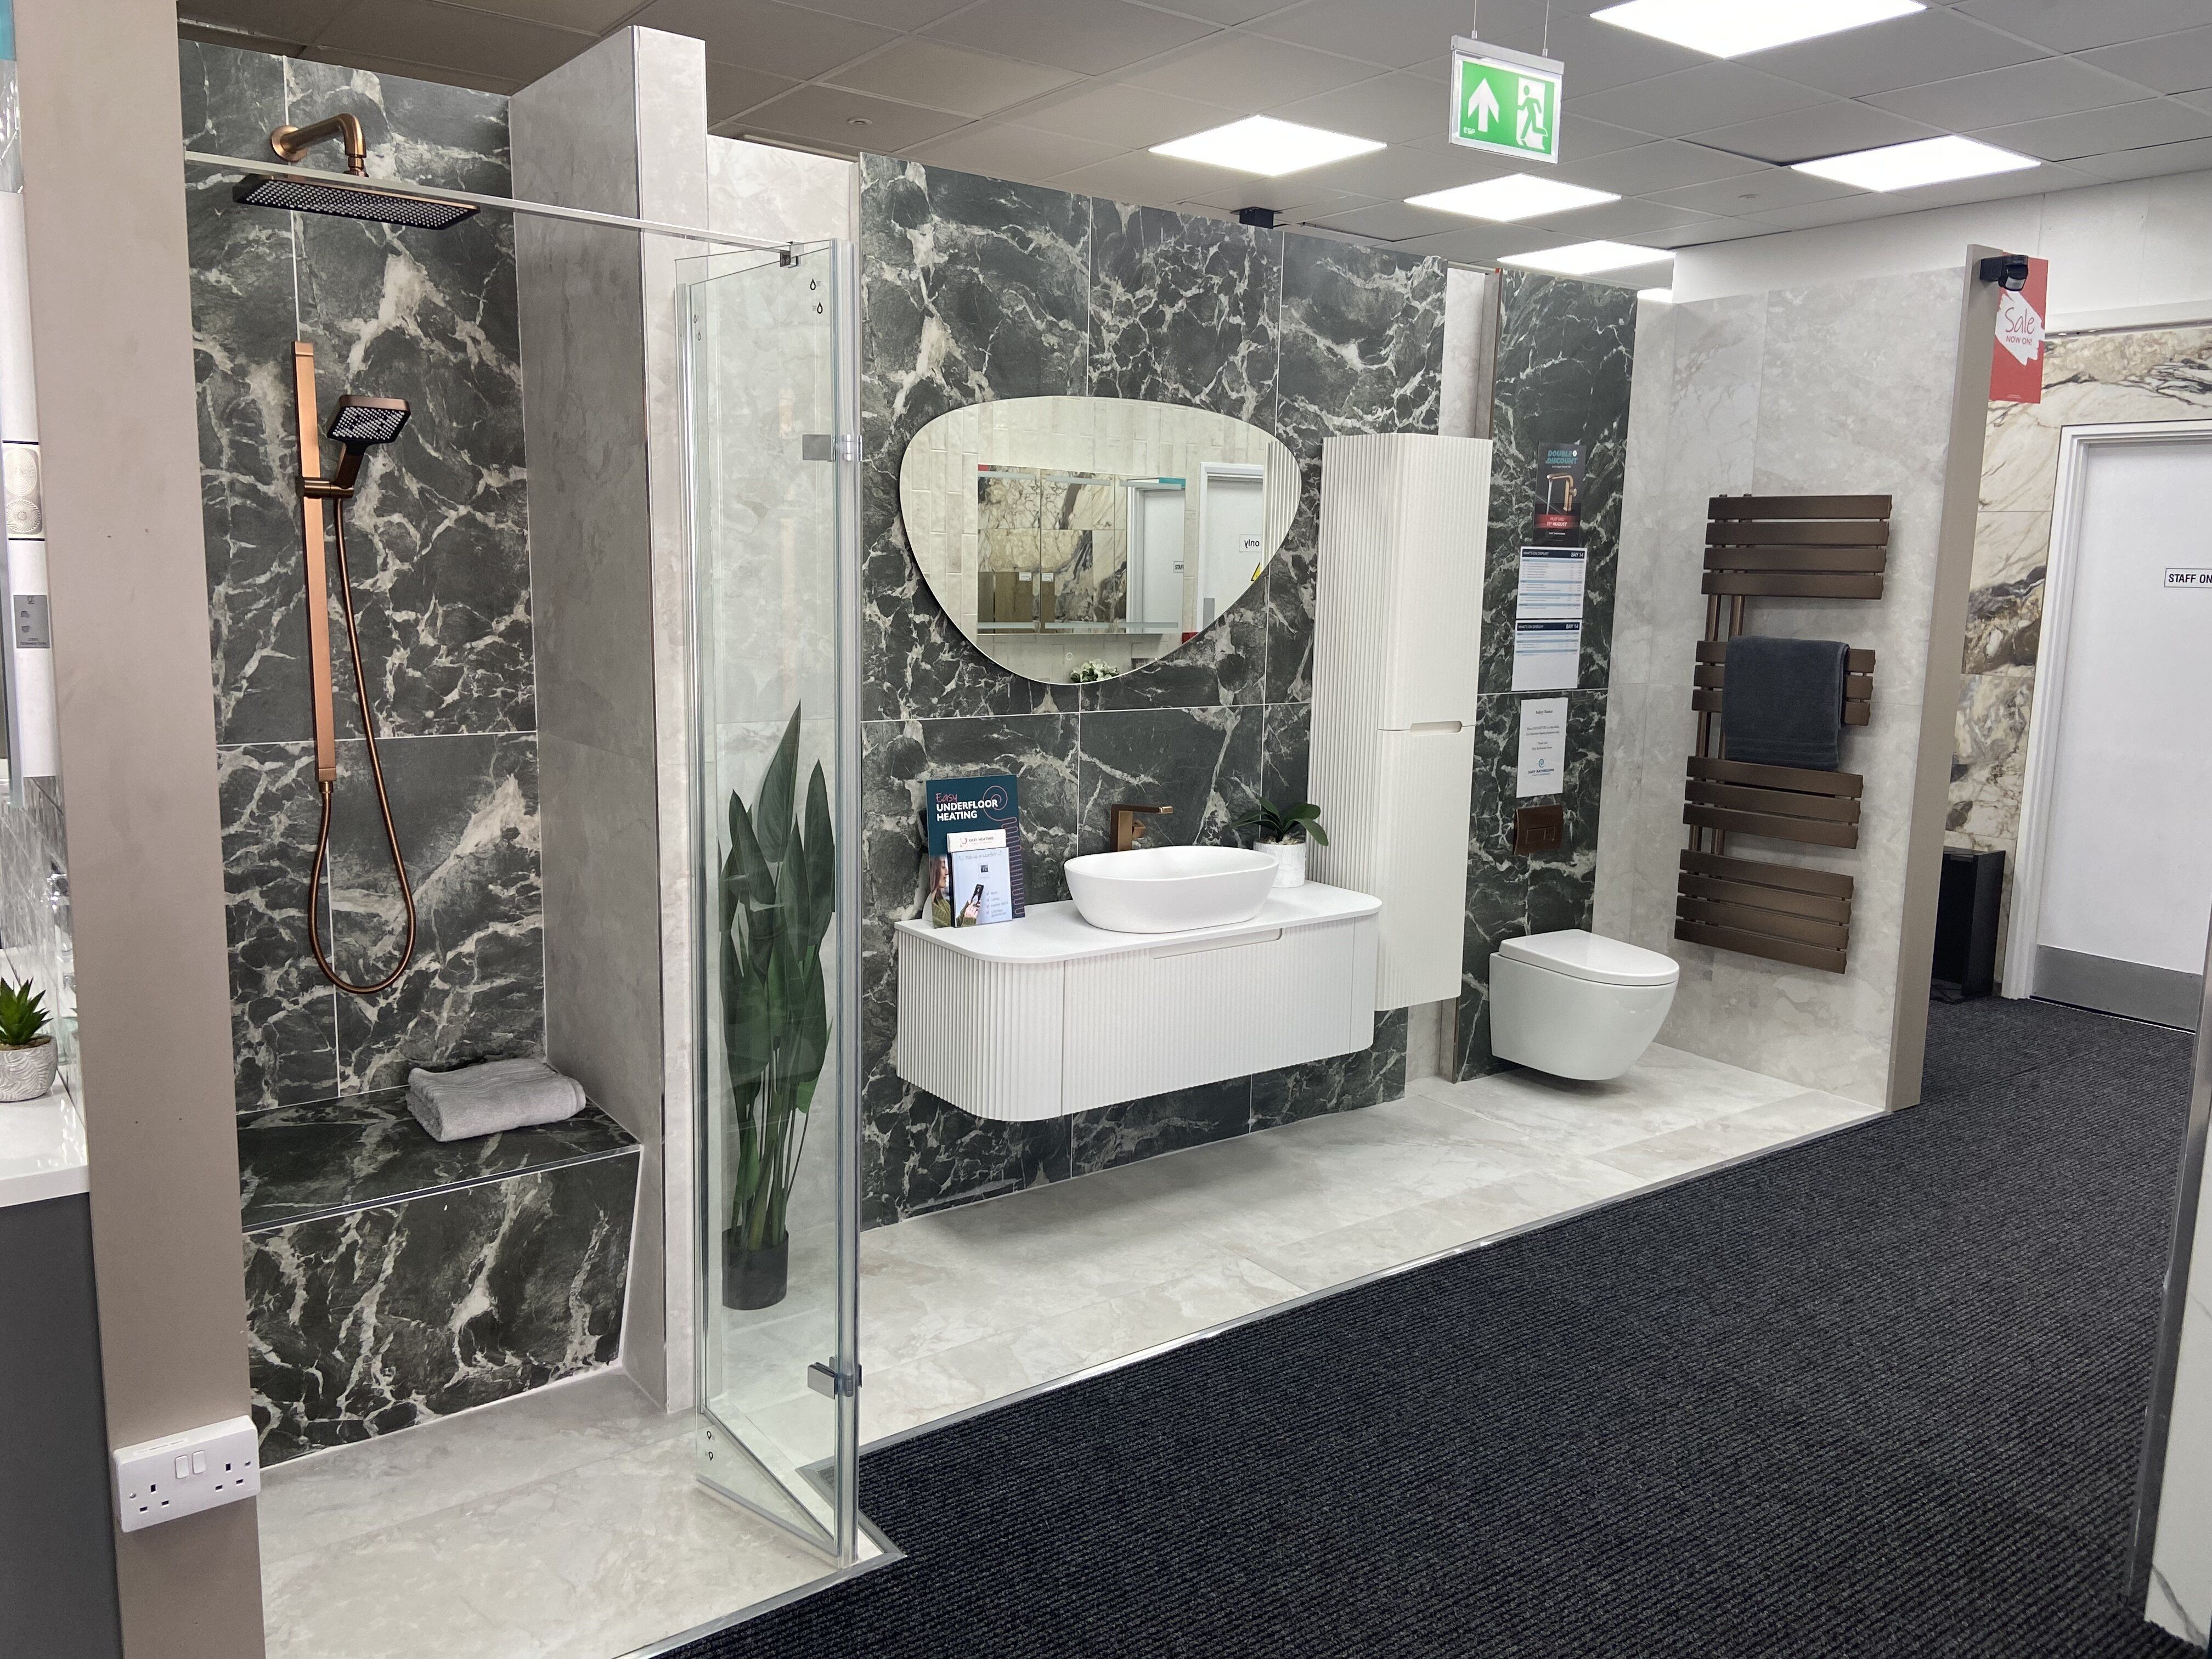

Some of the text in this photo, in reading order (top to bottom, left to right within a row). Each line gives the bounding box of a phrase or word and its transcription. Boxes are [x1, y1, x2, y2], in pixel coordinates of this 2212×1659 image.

[2005, 307, 2035, 334] Sale
[2006, 335, 2021, 343] NOW
[2168, 573, 2212, 584] STAFF ON
[935, 792, 957, 803] Easy
[936, 799, 998, 812] UNDERFLOOR
[936, 810, 978, 822] HEATING
